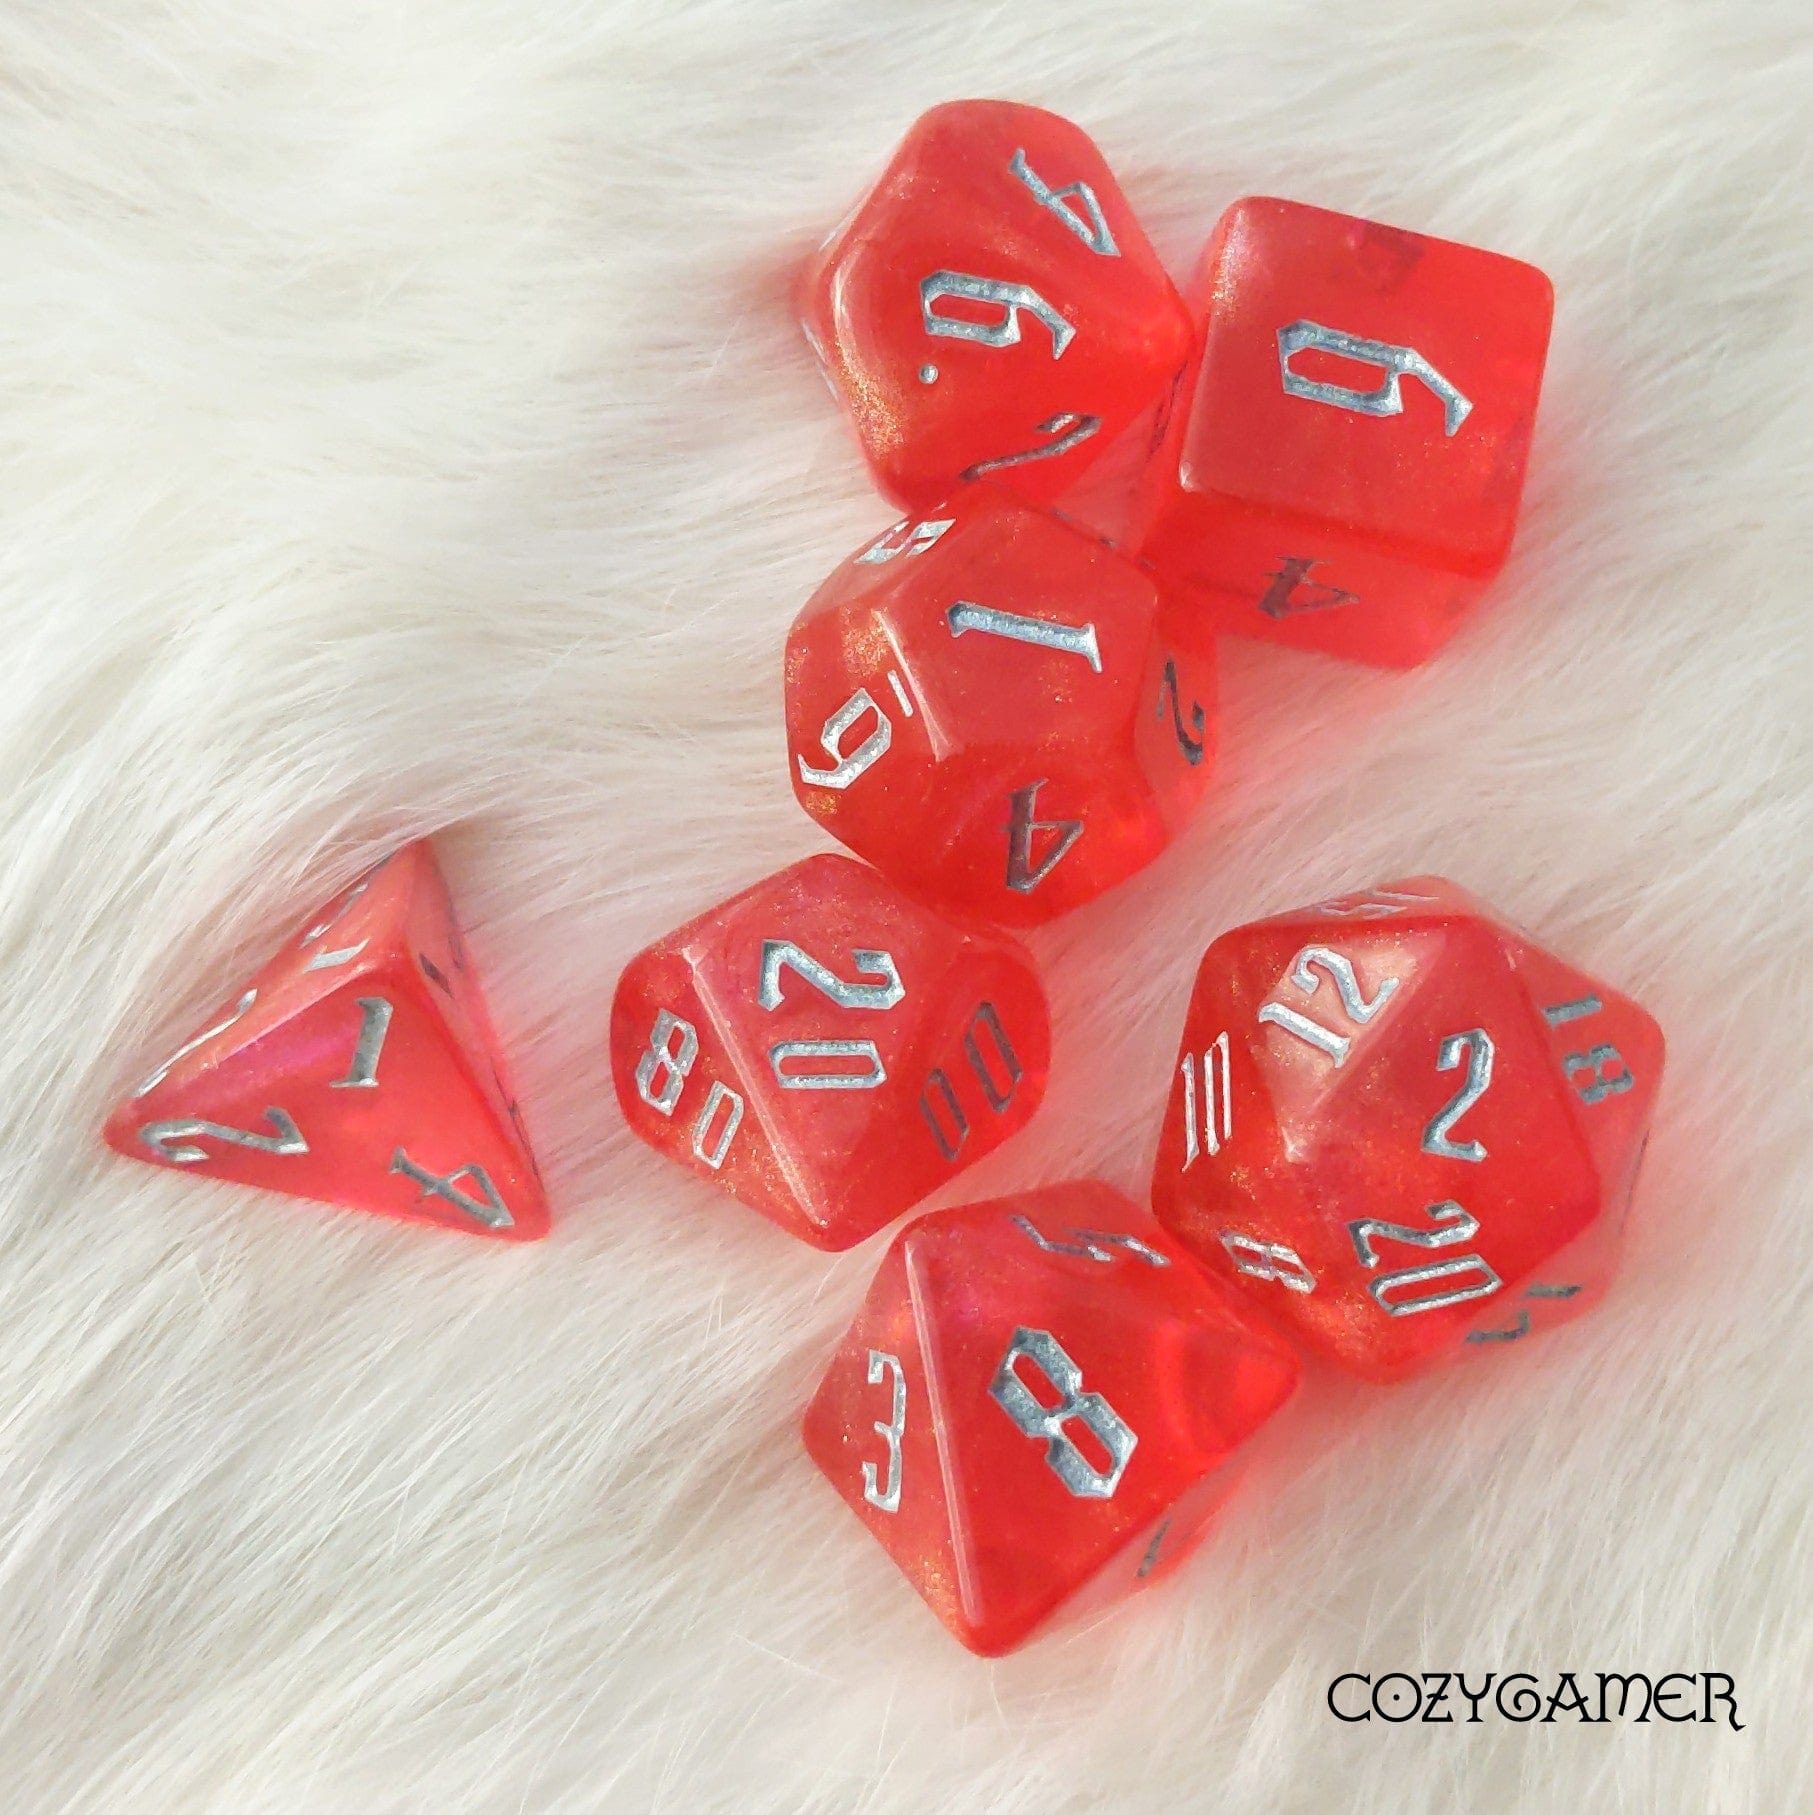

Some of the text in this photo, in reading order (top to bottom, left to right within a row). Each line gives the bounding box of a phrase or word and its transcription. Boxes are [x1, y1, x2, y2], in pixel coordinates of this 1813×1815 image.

[1007, 147, 1122, 257] 4
[1276, 318, 1474, 438] 6
[945, 600, 1103, 674] 1
[1156, 655, 1206, 767] 2
[1001, 776, 1085, 895] 4
[328, 996, 394, 1089] 1
[758, 938, 906, 1089] 20
[1257, 945, 1400, 1070] 12
[1540, 991, 1635, 1105] 18
[138, 1105, 310, 1162] 2
[634, 1007, 745, 1171] 80
[918, 1000, 1024, 1163] 00
[1420, 1027, 1496, 1163] 2
[388, 1145, 515, 1228] 4
[1218, 1229, 1318, 1295] 8
[1348, 1199, 1504, 1318] 20
[861, 1348, 908, 1514] 3
[987, 1325, 1140, 1499] 8
